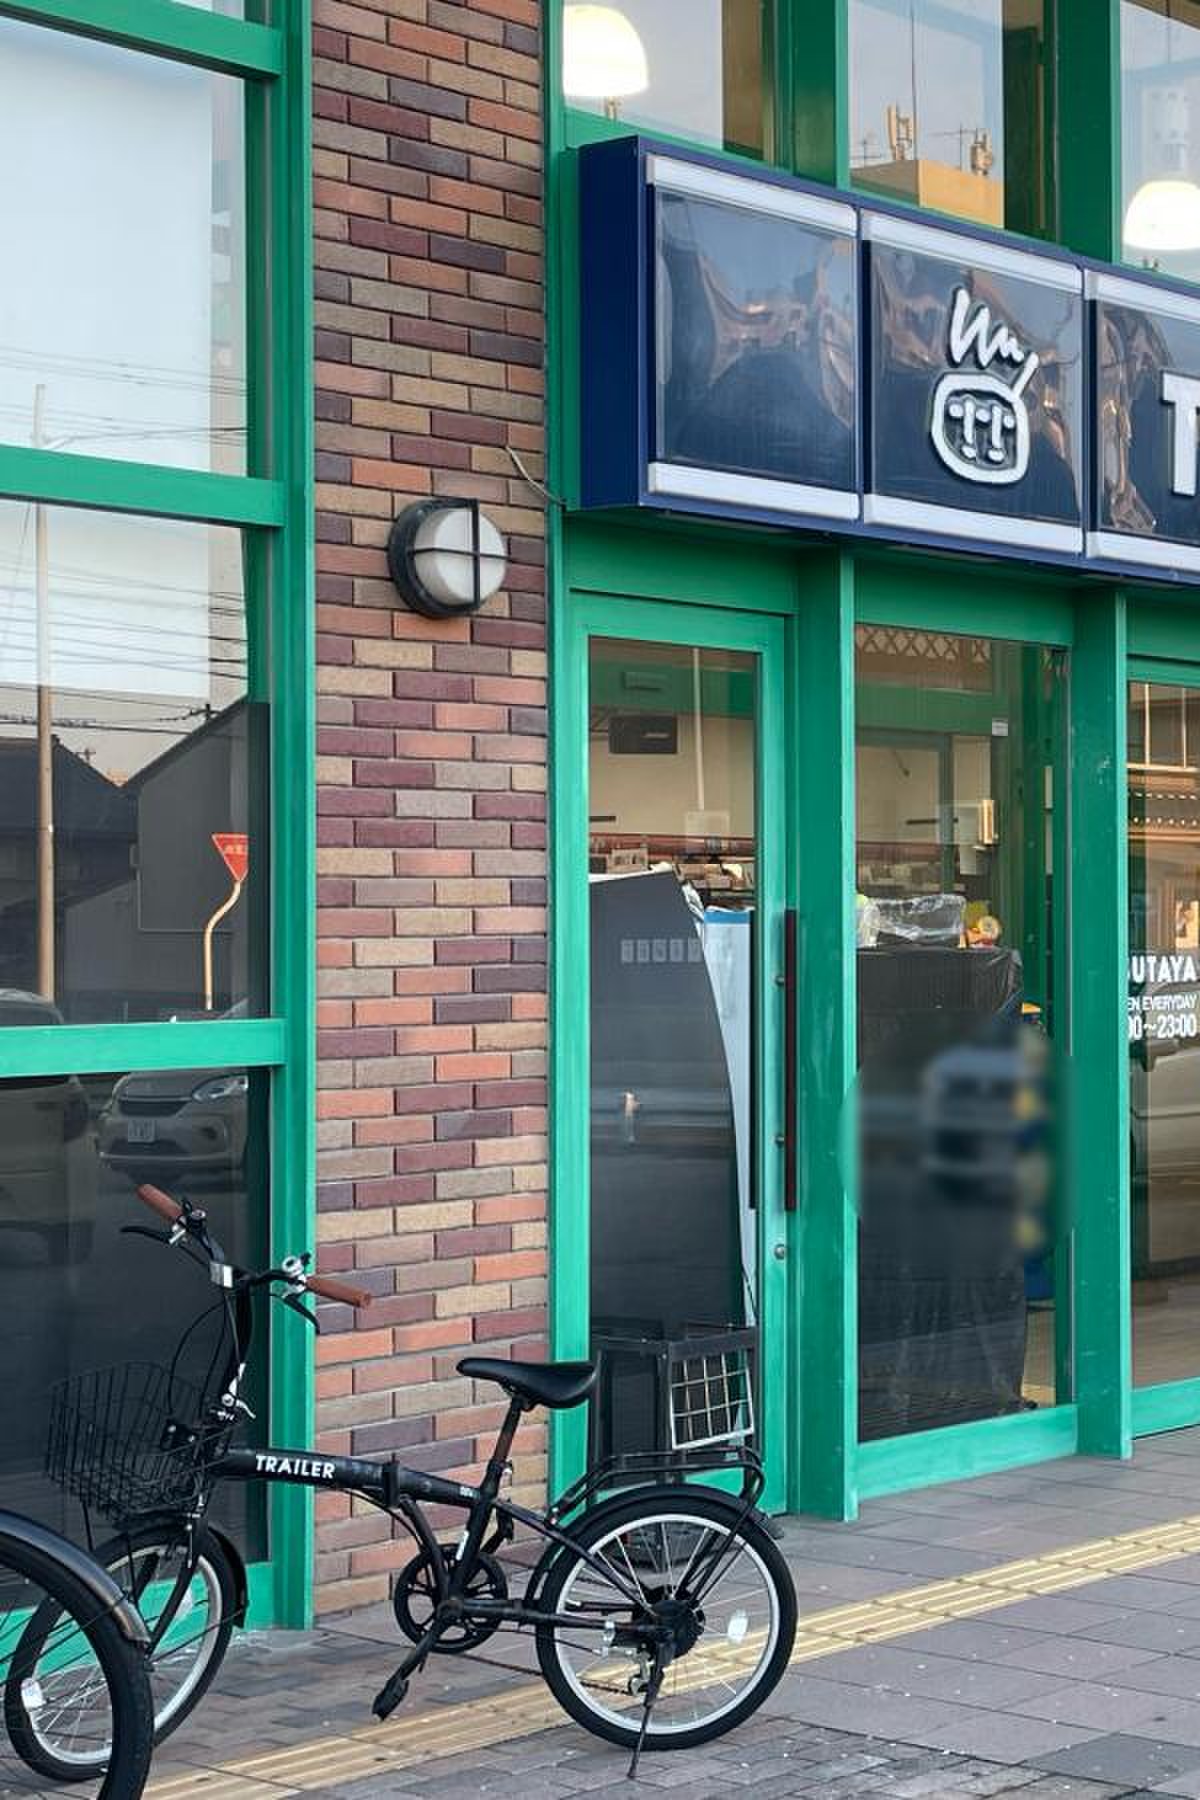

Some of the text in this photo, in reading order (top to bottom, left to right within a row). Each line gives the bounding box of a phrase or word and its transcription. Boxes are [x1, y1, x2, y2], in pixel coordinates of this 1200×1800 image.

[1129, 955, 1197, 983] UTAYA
[1142, 994, 1197, 1011] EVERYDAY
[255, 1454, 336, 1479] TRAILER
